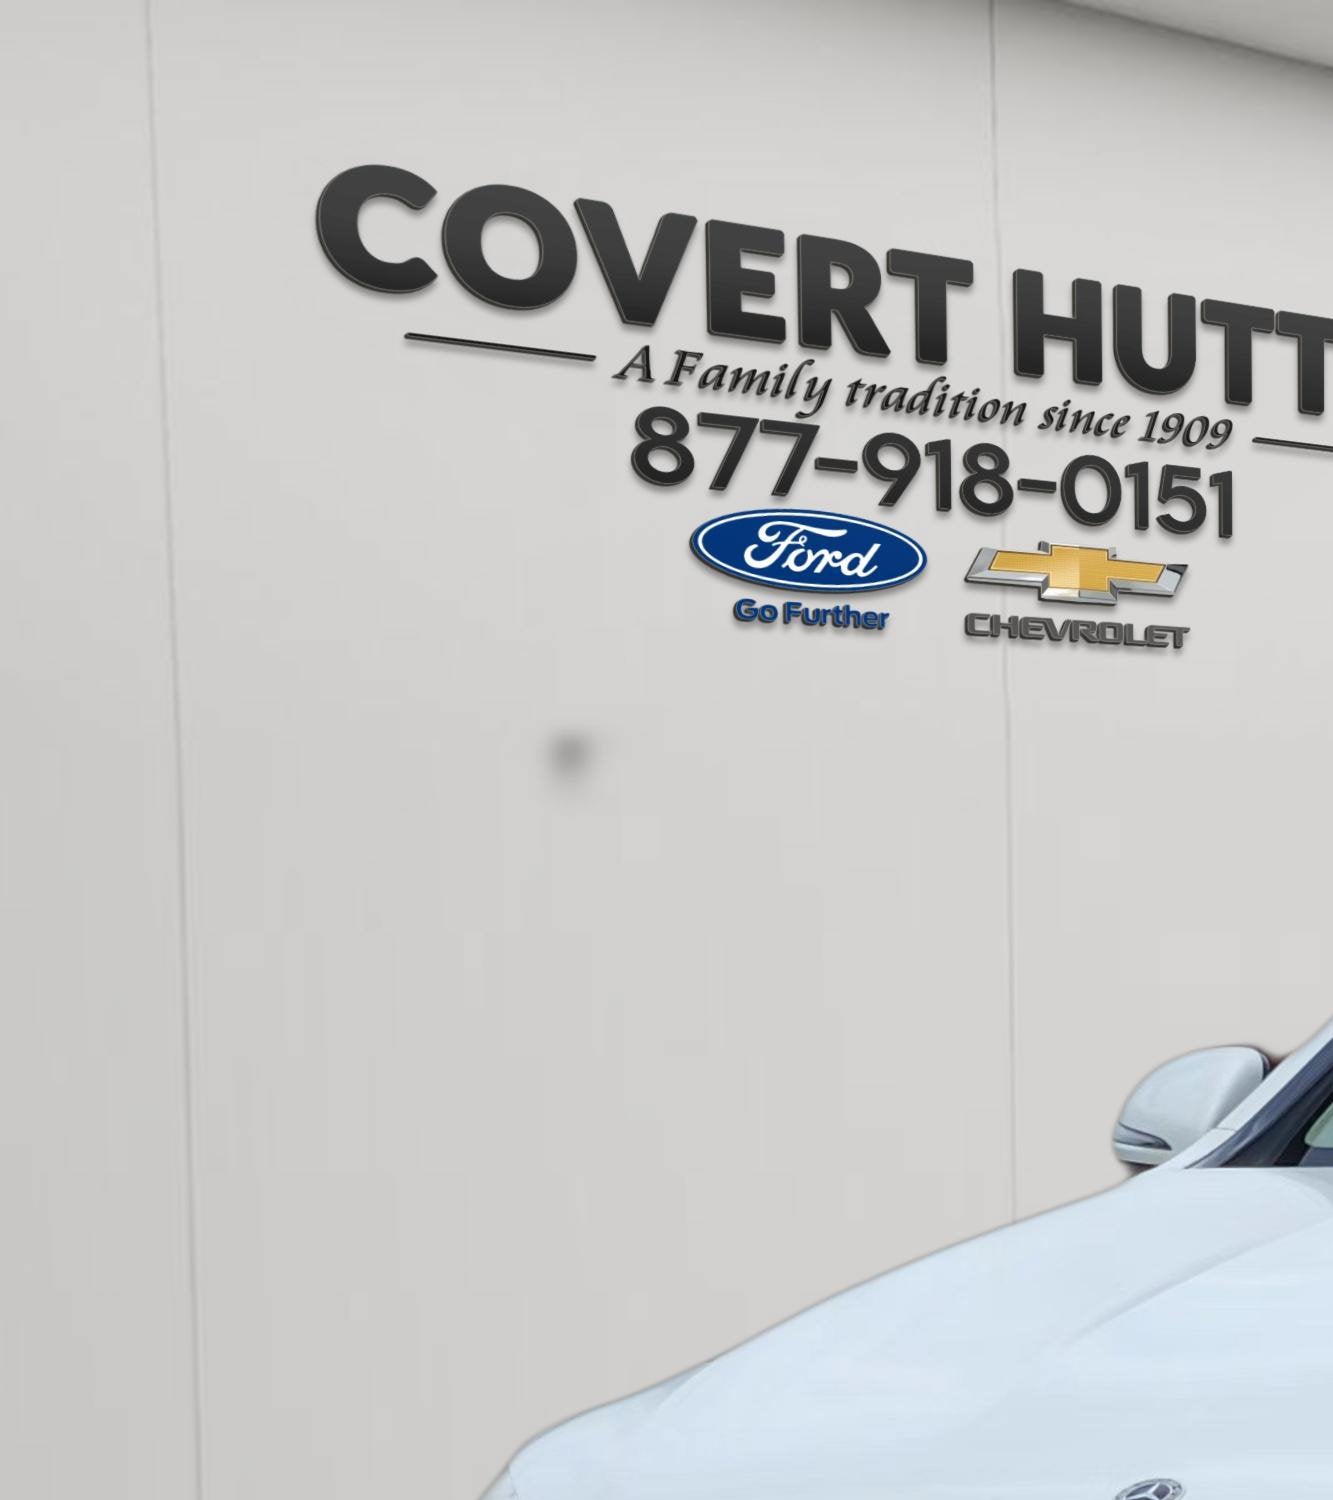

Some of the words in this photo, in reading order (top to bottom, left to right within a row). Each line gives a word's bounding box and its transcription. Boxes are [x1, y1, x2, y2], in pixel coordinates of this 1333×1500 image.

[315, 164, 975, 368] COVERT
[612, 345, 656, 384] A
[662, 349, 834, 421] Family
[845, 375, 1028, 428] tradition
[1037, 405, 1132, 441] since
[1138, 410, 1235, 452] 1909
[630, 406, 1235, 541] 877-918-0151
[743, 519, 880, 579] Ford
[732, 597, 780, 626] Go
[785, 601, 891, 632] Further
[964, 612, 1192, 651] CHEVROLET
